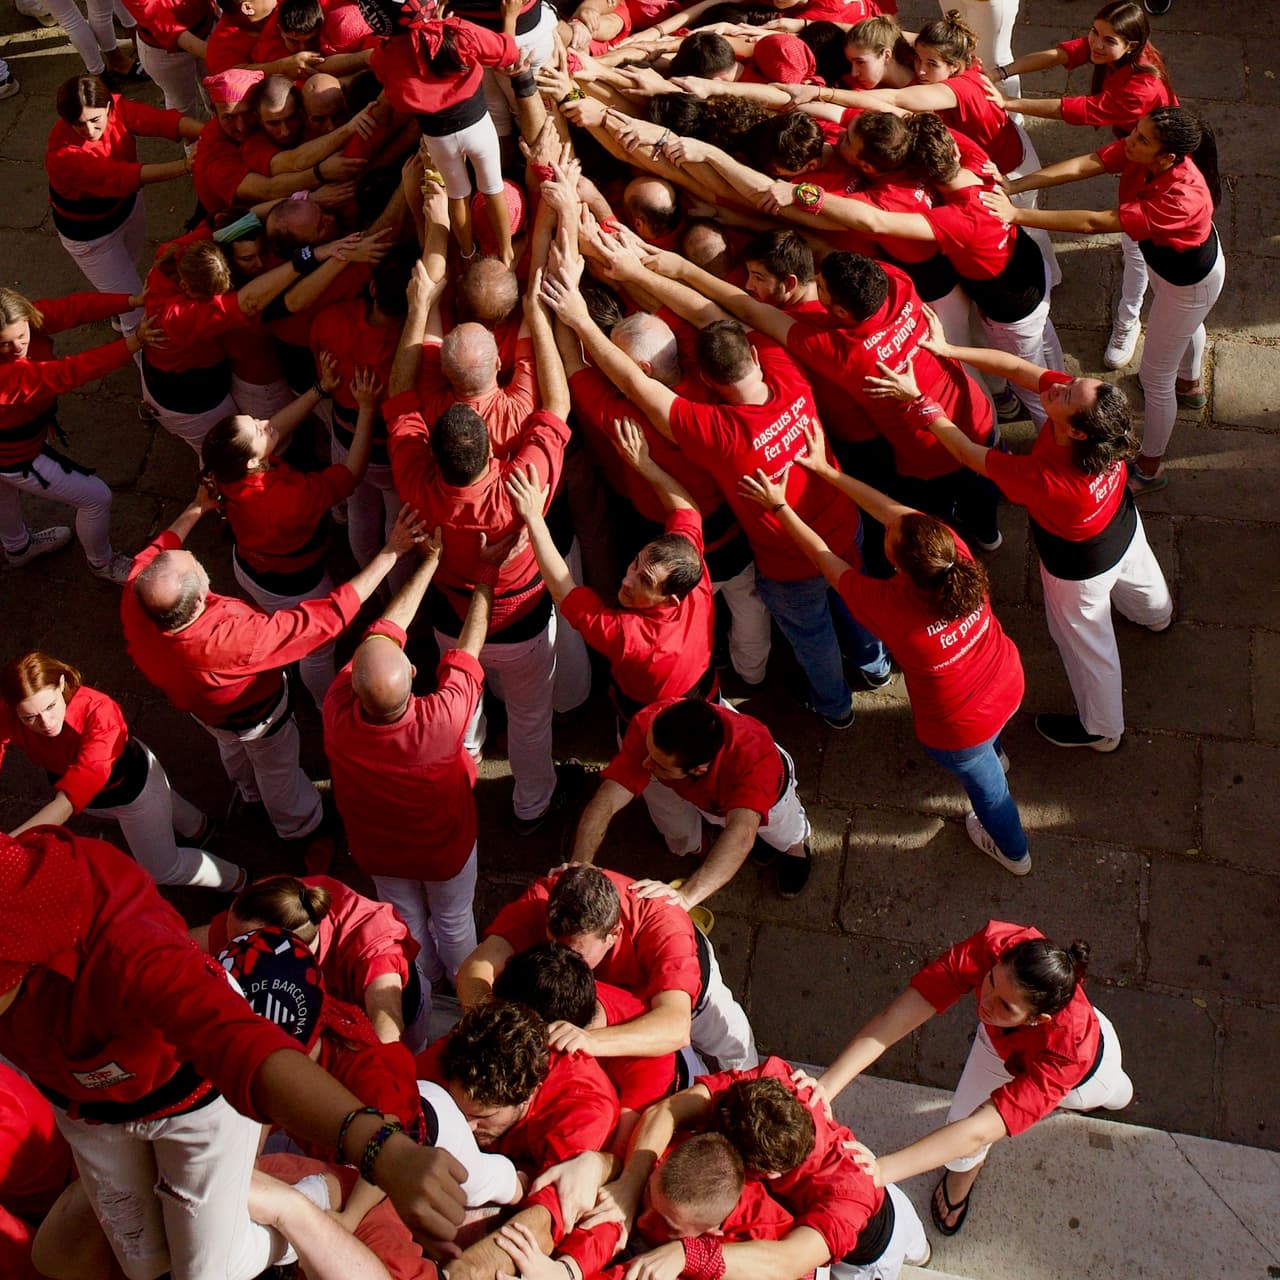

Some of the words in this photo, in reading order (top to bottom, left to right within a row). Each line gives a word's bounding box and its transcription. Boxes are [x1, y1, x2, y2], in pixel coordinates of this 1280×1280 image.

[876, 342, 894, 361] fer
[891, 317, 917, 352] pinya
[752, 411, 792, 451] nascuts
[763, 442, 781, 462] fer
[781, 413, 810, 452] pinya
[940, 630, 959, 650] fer
[251, 979, 269, 993] DE
[271, 978, 308, 1035] BARCELONA
